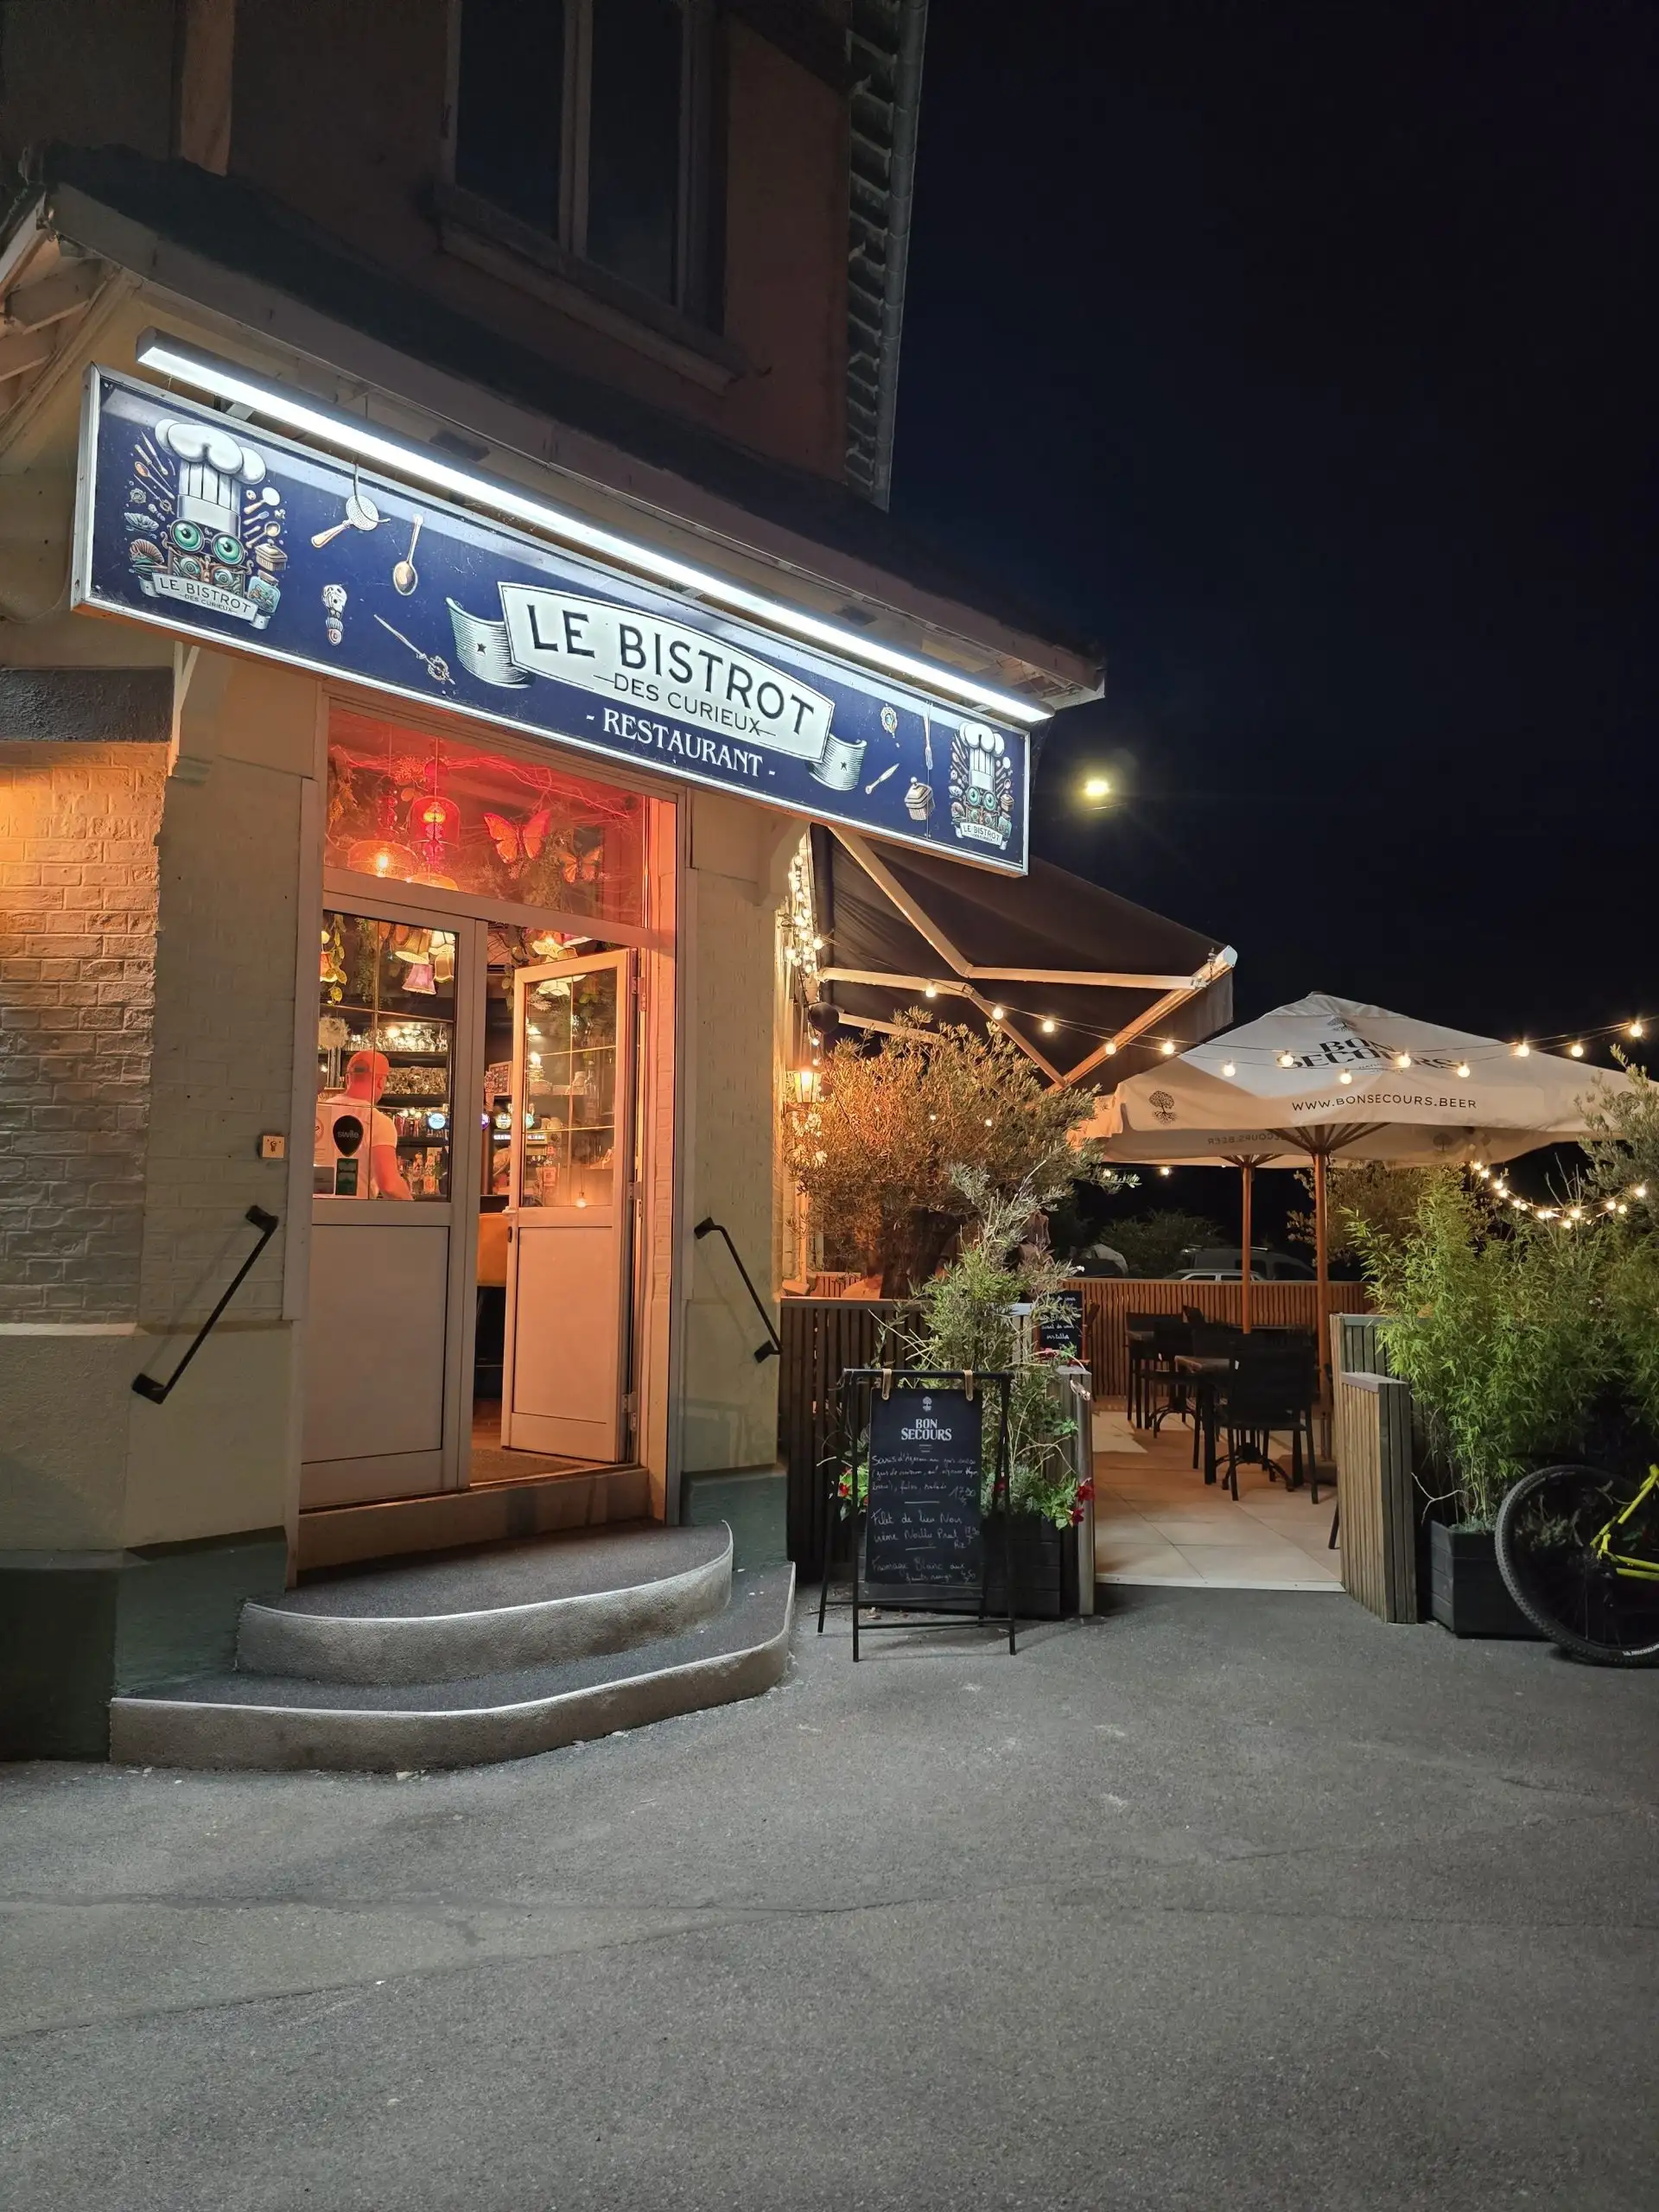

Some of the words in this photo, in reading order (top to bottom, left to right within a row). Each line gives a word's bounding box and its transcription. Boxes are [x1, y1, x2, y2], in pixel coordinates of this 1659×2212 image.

[159, 577, 180, 591] LE
[186, 582, 251, 613] BISTROT
[184, 594, 200, 602] DES
[201, 599, 232, 613] CURIEUX
[526, 604, 596, 659] LE
[619, 622, 815, 736] BISTROT
[613, 672, 659, 702] DES
[667, 691, 761, 736] CURIEUX
[602, 707, 763, 777] RESTAURANT
[963, 824, 972, 833] LE
[973, 825, 1000, 842] BISTROT
[1319, 1037, 1397, 1053] BON
[1292, 1093, 1478, 1111] WWW.BONSECOURS.BEER
[915, 1418, 938, 1429] BON
[900, 1427, 952, 1441] SECOURS
